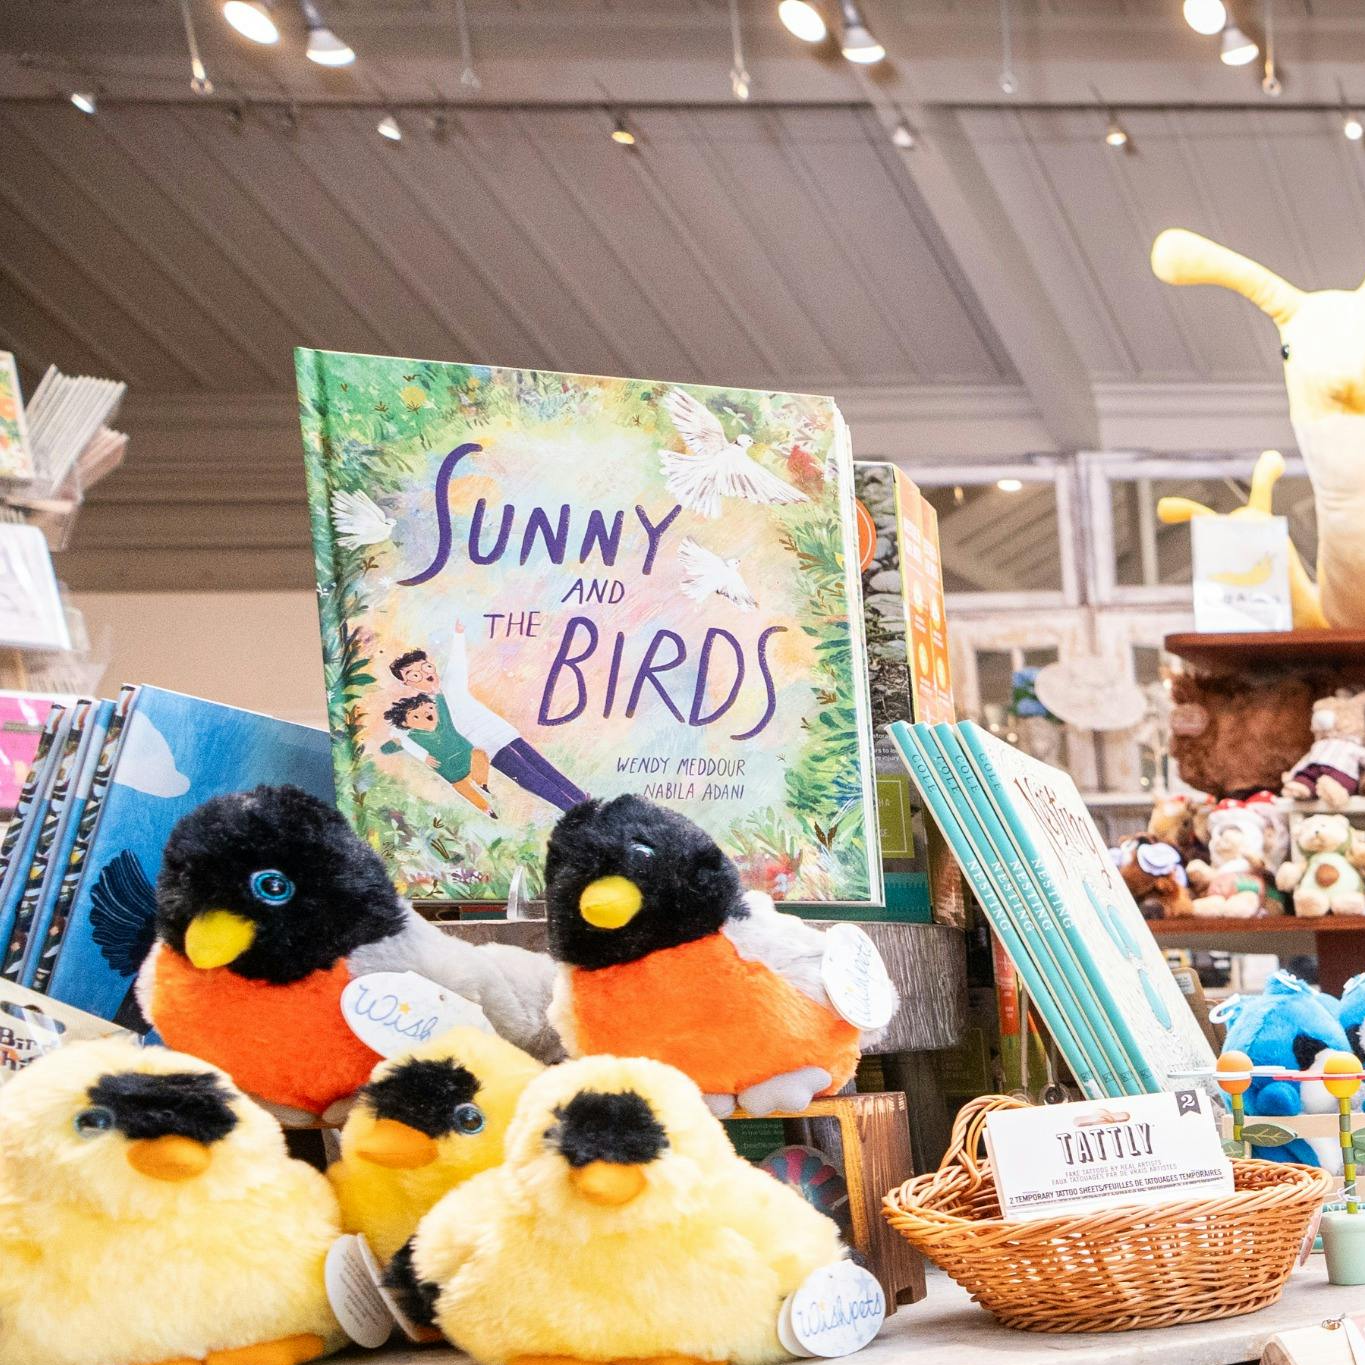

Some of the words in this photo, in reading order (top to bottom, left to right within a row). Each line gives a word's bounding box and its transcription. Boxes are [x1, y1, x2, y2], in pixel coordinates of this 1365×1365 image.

[397, 443, 682, 586] SUNNY
[562, 579, 625, 605] AND
[483, 612, 542, 639] THE
[537, 616, 788, 741] BIRDS
[616, 757, 671, 776] WENDY
[676, 757, 746, 776] MEDDOUR
[911, 754, 936, 793] COLE
[955, 755, 979, 793] COLE
[979, 753, 1001, 790] COLE
[643, 782, 697, 799] NABILA
[702, 782, 744, 800] ADANI
[967, 860, 1011, 931] NESTING
[992, 861, 1034, 933] NESTING
[1009, 860, 1053, 931] NESTING
[1031, 859, 1074, 929] NESTING
[355, 984, 439, 1041] Wish
[1181, 1094, 1196, 1109] 2
[1057, 1123, 1154, 1165] TATTLY
[1015, 1191, 1054, 1204] TEMPORARY
[1144, 1174, 1178, 1186] TATOUAGES
[1179, 1169, 1223, 1182] TEMPORAIRES
